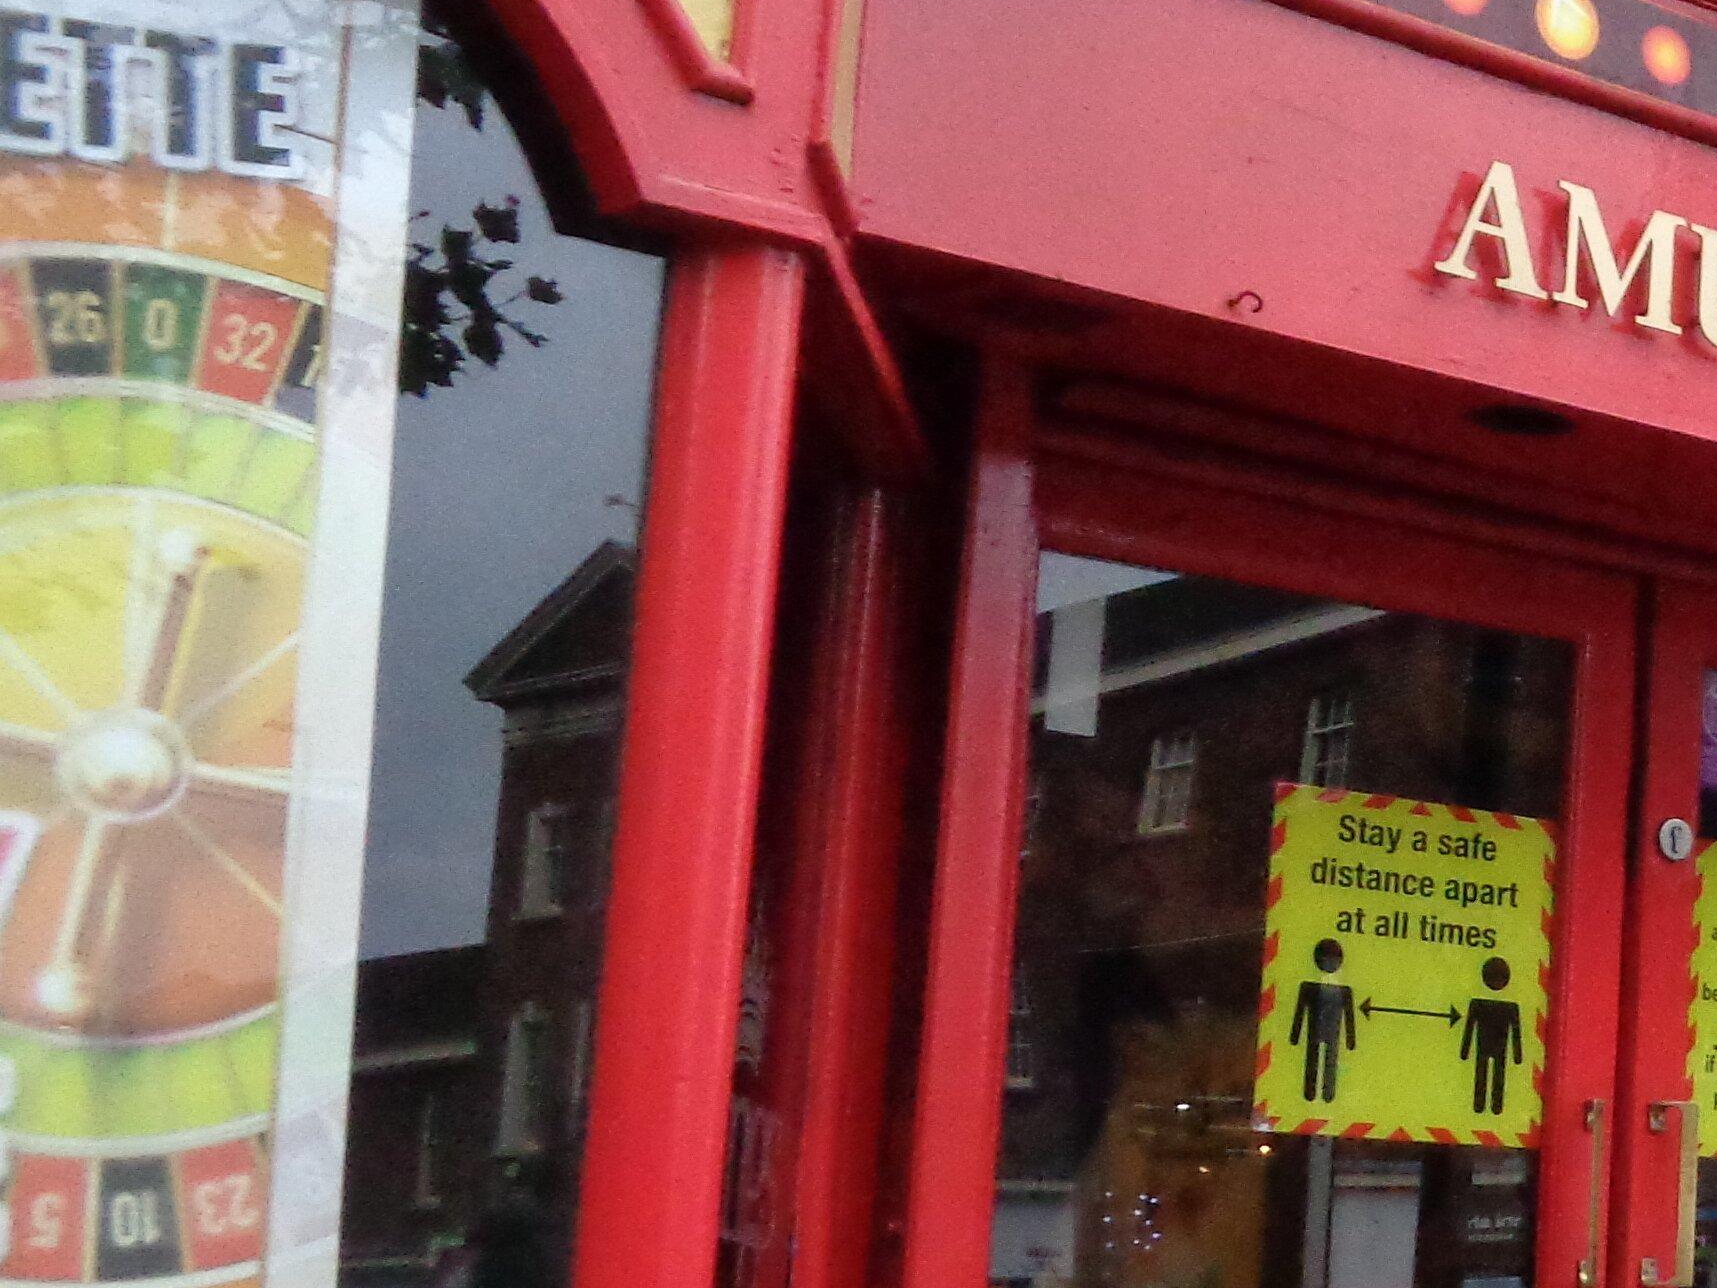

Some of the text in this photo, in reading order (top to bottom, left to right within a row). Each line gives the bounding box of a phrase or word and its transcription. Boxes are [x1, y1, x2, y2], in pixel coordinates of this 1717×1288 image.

[143, 297, 181, 353] 0
[214, 314, 277, 373] 32
[1337, 813, 1497, 862] Stay a safe
[1310, 857, 1519, 909] distance apart
[1335, 908, 1497, 950] at all times
[1704, 1054, 1716, 1073] if
[109, 1189, 163, 1249] 10
[193, 1173, 258, 1234] 23
